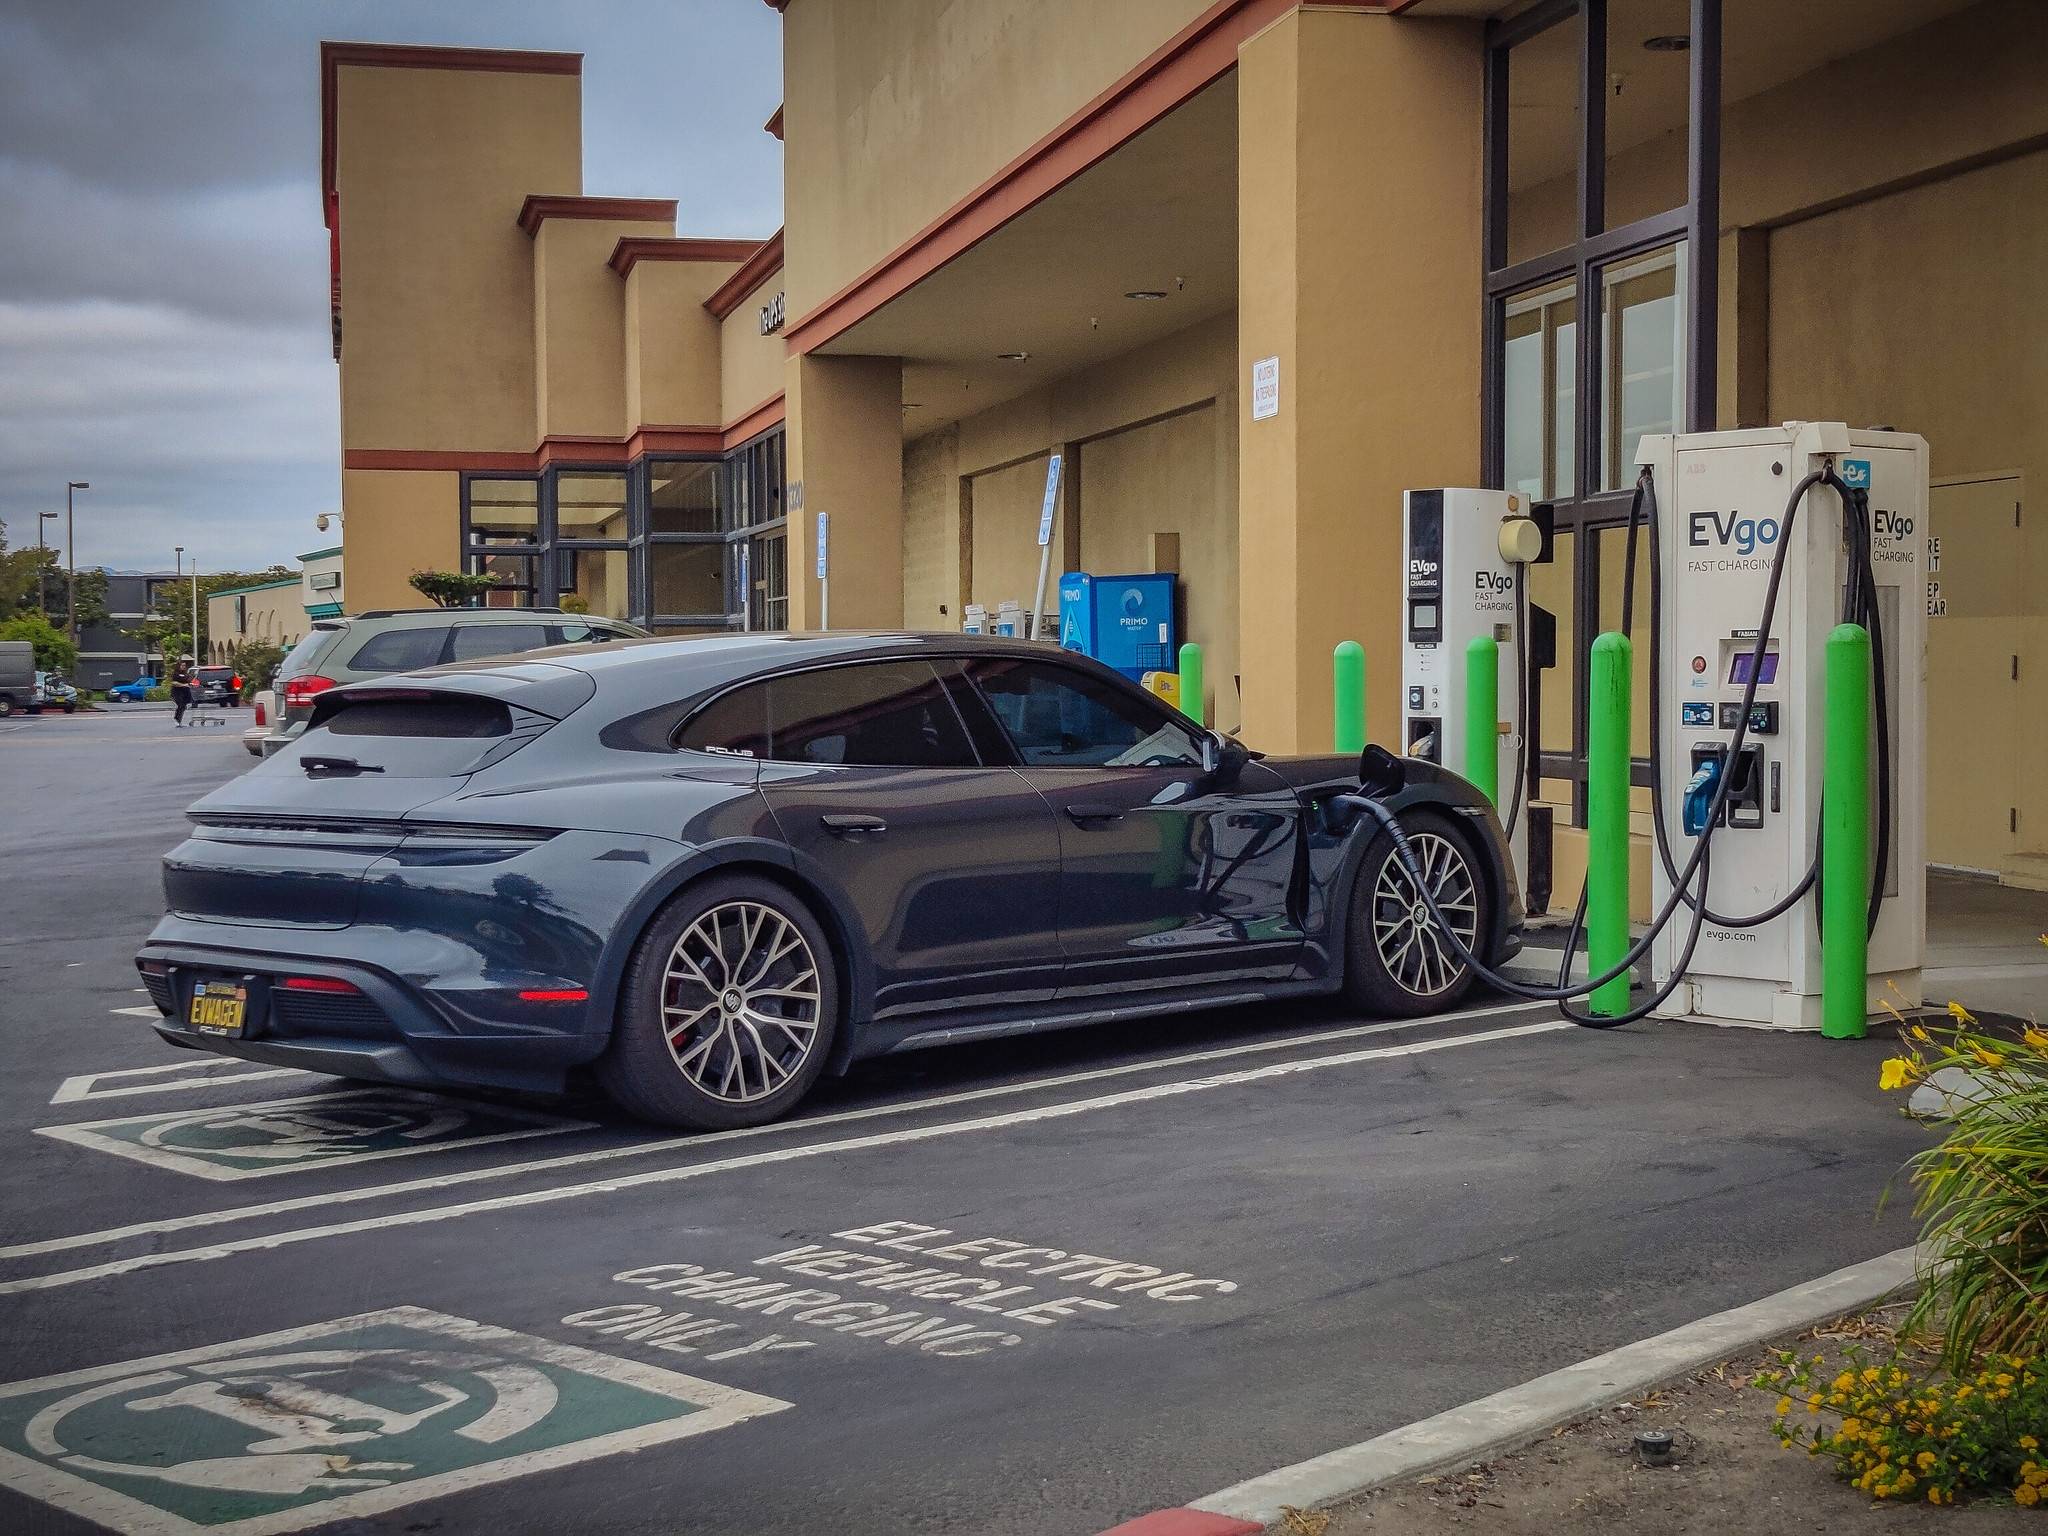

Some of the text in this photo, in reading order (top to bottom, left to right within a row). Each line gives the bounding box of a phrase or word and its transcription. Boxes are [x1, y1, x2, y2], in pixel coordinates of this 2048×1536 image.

[1689, 510, 1779, 556] EVgo
[1874, 509, 1914, 541] EVgo
[1874, 537, 1892, 549] FAST
[1927, 537, 1940, 554] RE
[1873, 550, 1914, 563] CHARGING
[1928, 555, 1940, 572] IT
[1410, 559, 1438, 576] EVgo
[1688, 560, 1715, 572] FAST
[1475, 571, 1513, 595] EVgo
[1927, 582, 1939, 598] EP
[1063, 589, 1080, 602] PRIMO
[1475, 592, 1493, 601] FAST
[1474, 602, 1513, 611] CHARGING
[1927, 600, 1946, 616] EAR
[1120, 617, 1148, 626] PRIMO
[1706, 930, 1756, 942] evgo.com
[829, 1220, 1238, 1301] ELECTRIC
[752, 1244, 1121, 1325] VEHICLE
[612, 1262, 1022, 1356] CHARGING
[560, 1303, 818, 1361] ONLY
